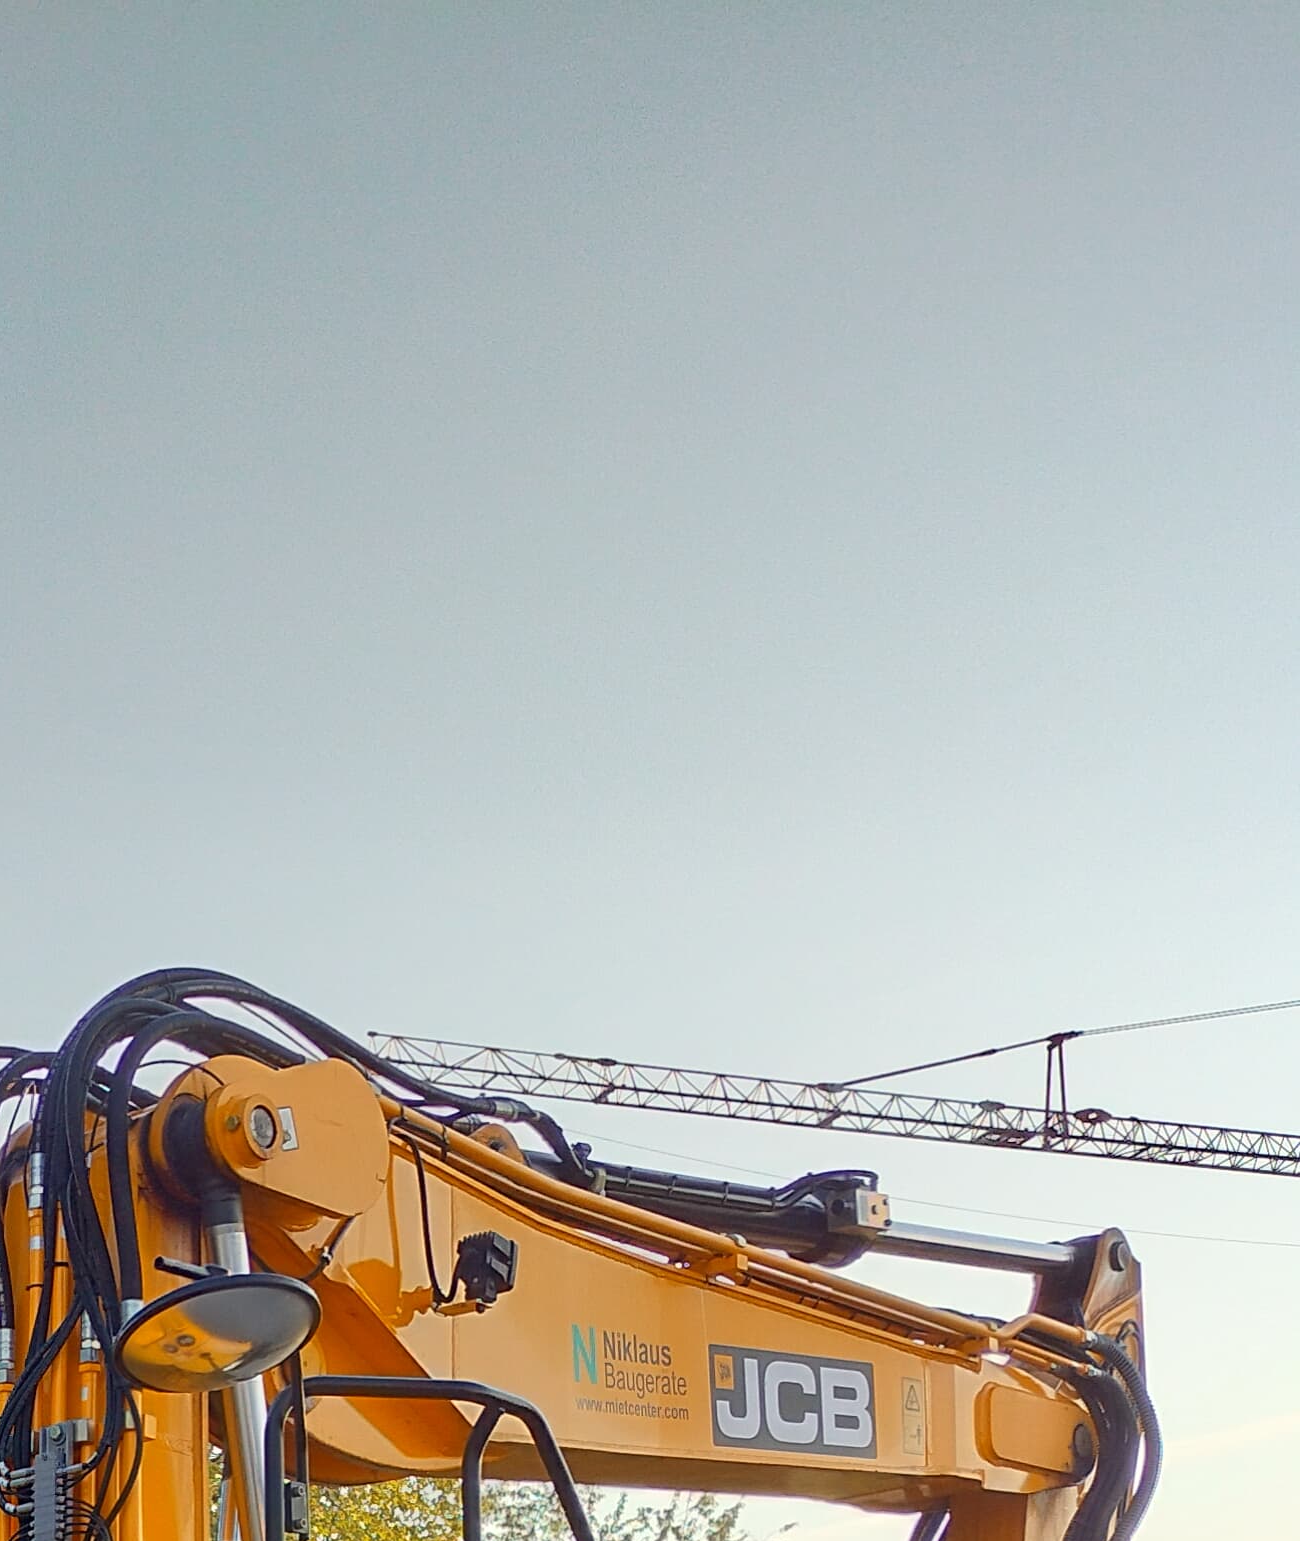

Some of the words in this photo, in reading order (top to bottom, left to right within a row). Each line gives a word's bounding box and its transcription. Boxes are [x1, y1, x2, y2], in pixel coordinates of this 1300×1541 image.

[571, 1323, 598, 1385] N
[603, 1330, 672, 1367] Niklaus
[574, 1397, 690, 1420] www.mietcenter.com
[714, 1357, 873, 1449] JCB
